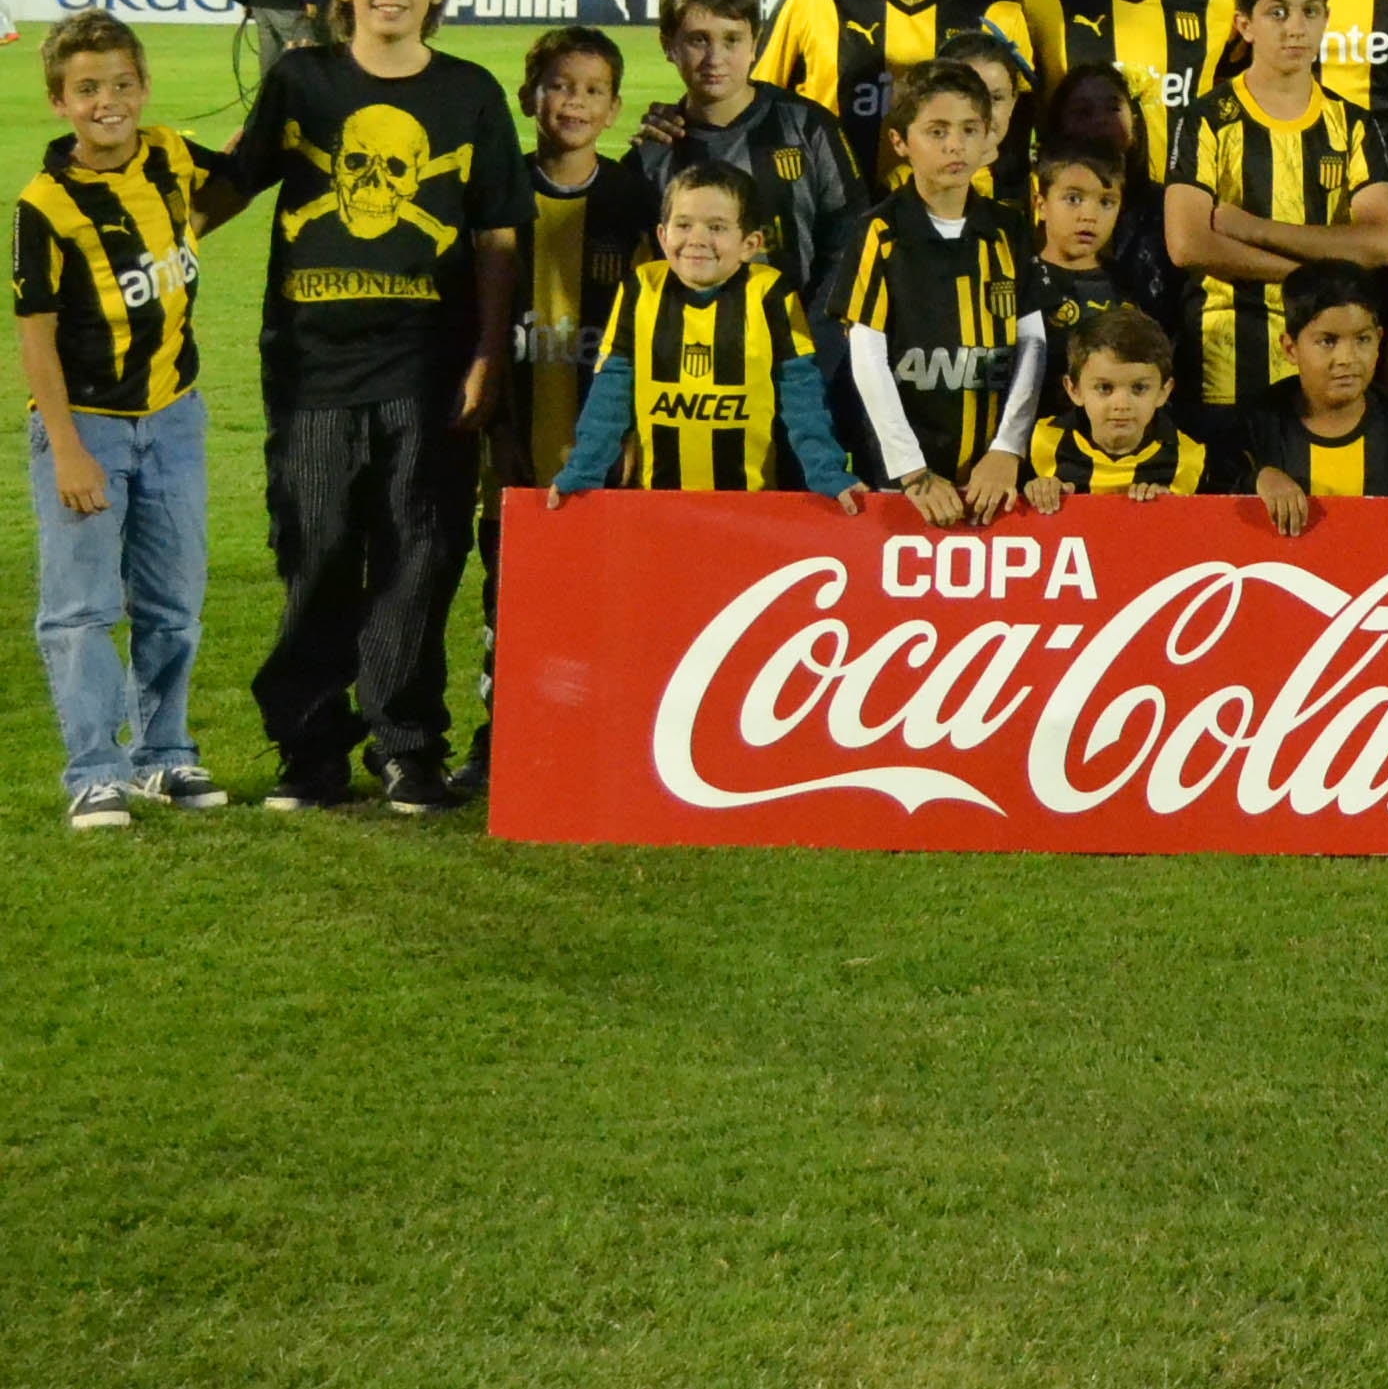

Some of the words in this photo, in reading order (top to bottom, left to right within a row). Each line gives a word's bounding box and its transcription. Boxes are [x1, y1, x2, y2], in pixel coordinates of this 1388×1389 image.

[894, 346, 1009, 391] ANCE
[650, 391, 751, 421] ANCEL
[882, 534, 1098, 600] COPA
